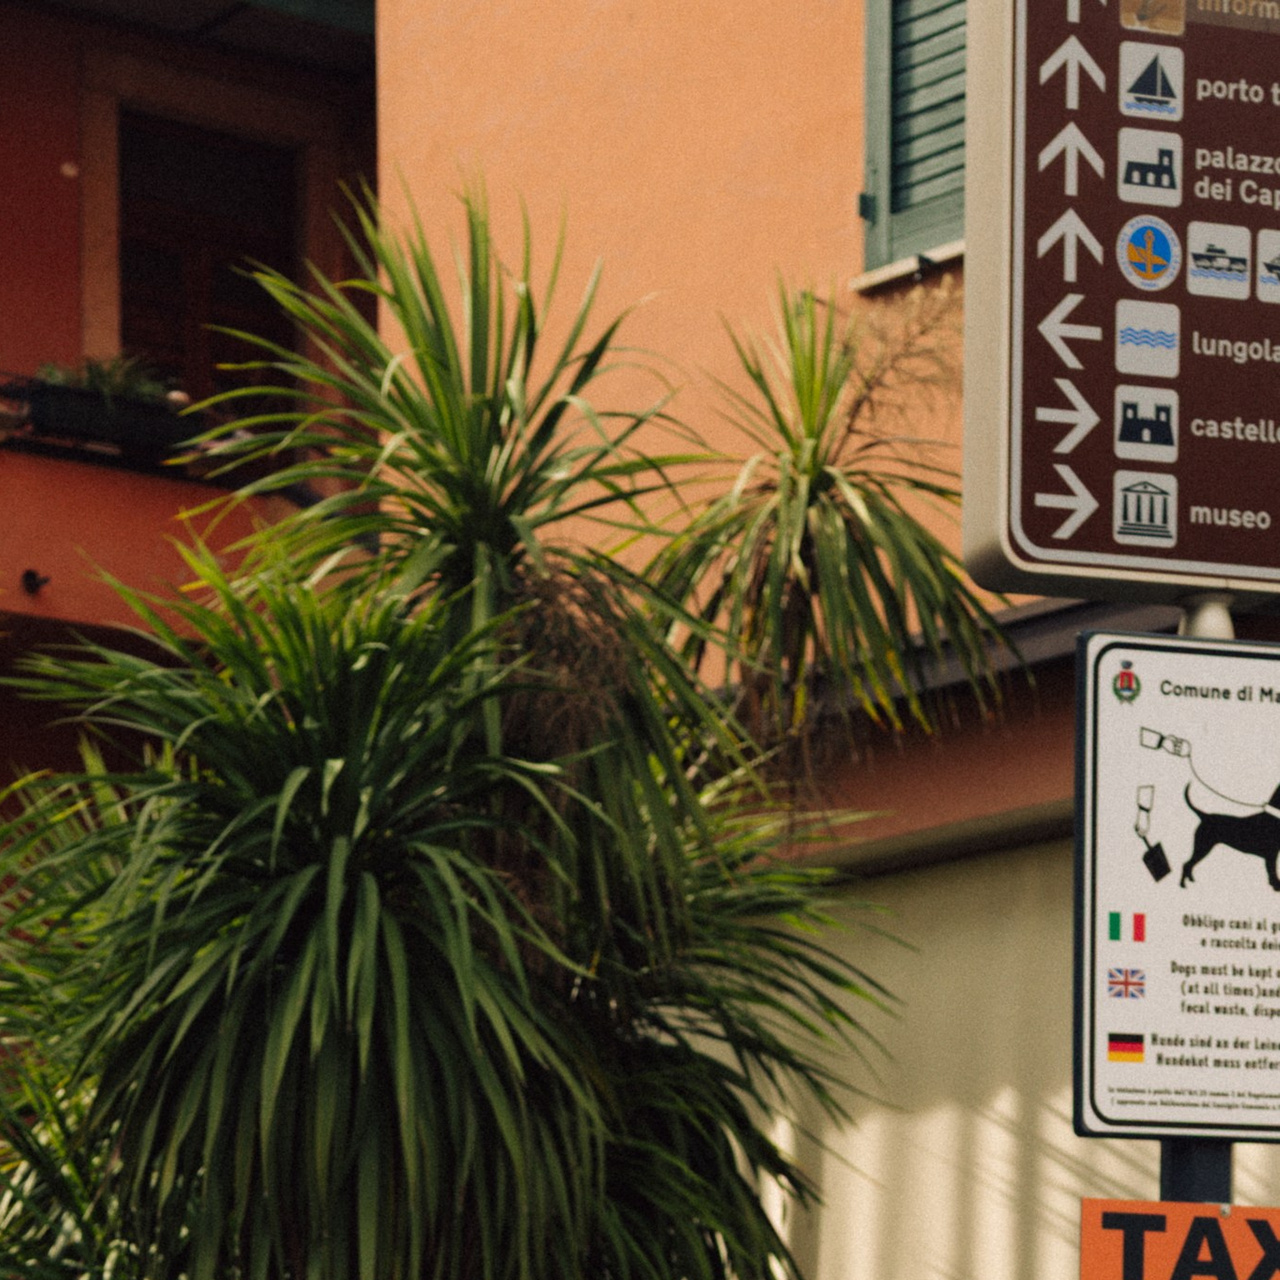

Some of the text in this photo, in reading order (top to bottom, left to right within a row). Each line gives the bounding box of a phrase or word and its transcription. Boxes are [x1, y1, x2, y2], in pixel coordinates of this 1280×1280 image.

[1196, 78, 1265, 103] porto
[1194, 175, 1232, 202] dei
[1192, 330, 1280, 363] lungola
[1189, 505, 1271, 530] museo
[1160, 680, 1231, 700] Comune
[1237, 685, 1253, 701] di
[1182, 914, 1225, 931] Obbligo
[1229, 917, 1252, 930] cani
[1256, 917, 1267, 931] al
[1201, 939, 1206, 947] e
[1210, 936, 1257, 950] raccolta
[1171, 960, 1197, 977] Dogs
[1201, 963, 1228, 977] must
[1232, 963, 1244, 976] be
[1248, 965, 1272, 980] kept
[1180, 980, 1200, 997] (at
[1203, 982, 1219, 995] all
[1180, 1001, 1210, 1014] fecal
[1151, 1033, 1185, 1047] Hunde
[1190, 1034, 1212, 1048] sind
[1216, 1038, 1229, 1049] an
[1233, 1035, 1250, 1049] der
[1156, 1053, 1209, 1068] Hundekot
[1213, 1056, 1240, 1069] muss
